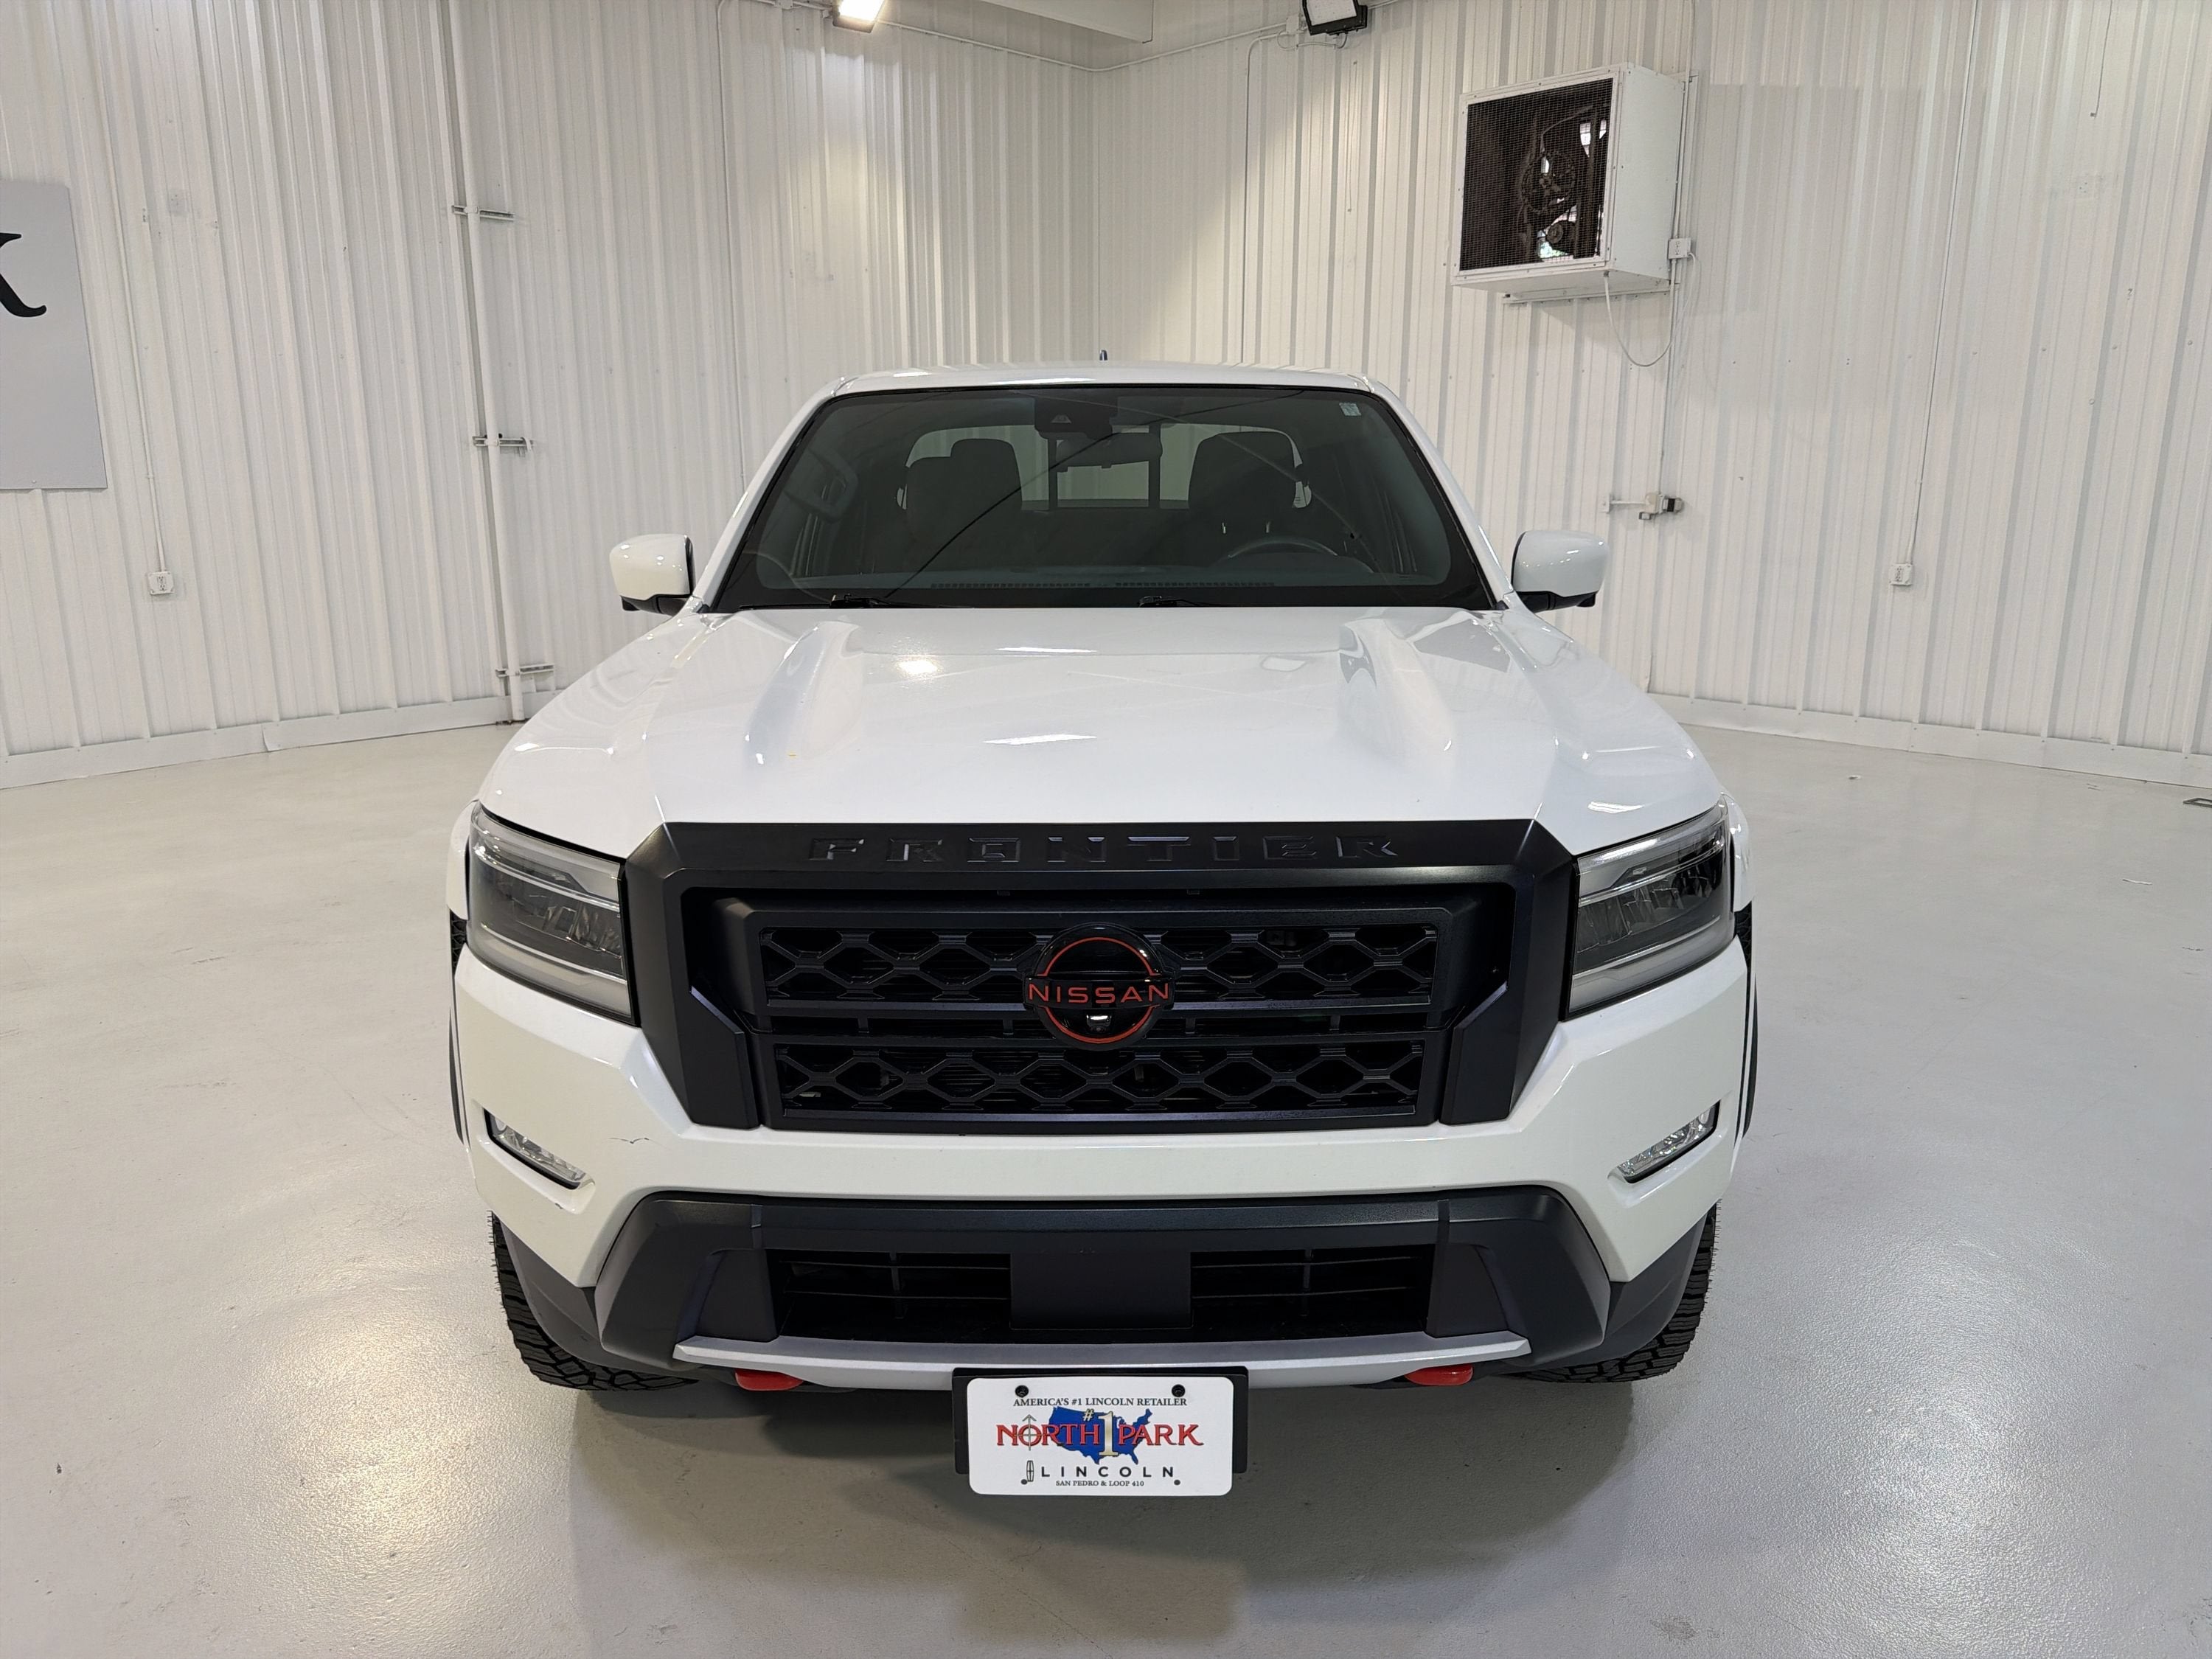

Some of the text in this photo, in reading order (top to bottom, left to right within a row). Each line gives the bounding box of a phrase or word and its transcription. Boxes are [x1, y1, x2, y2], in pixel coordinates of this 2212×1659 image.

[809, 835, 1399, 863] FRONTIER
[1028, 982, 1169, 1004] NISSAN
[1013, 1397, 1187, 1406] AMERICA'S #1 LINCOLN RETAILER
[995, 1424, 1204, 1446] NORTH PARK
[1041, 1466, 1174, 1478] LINCOLN
